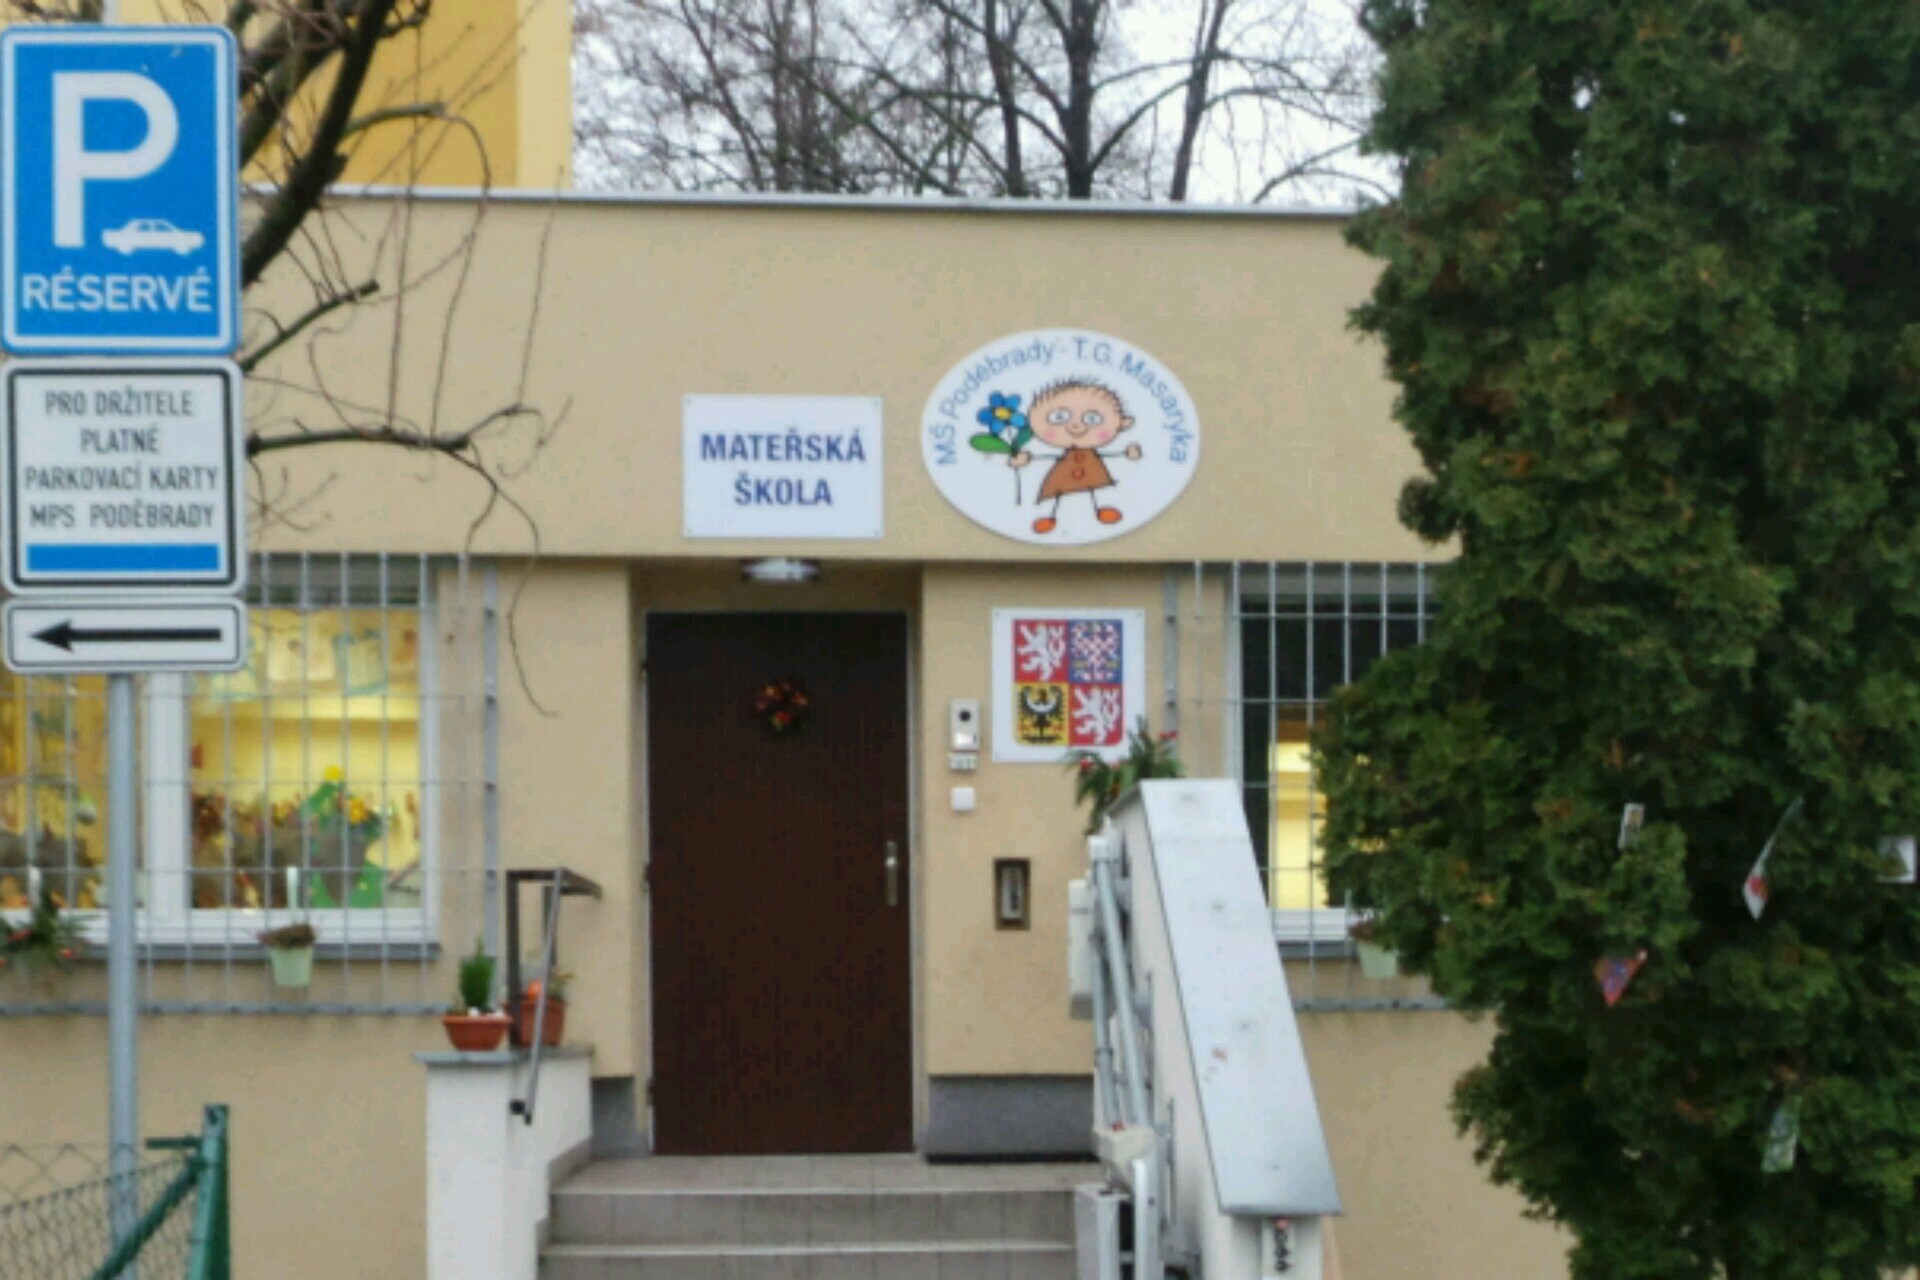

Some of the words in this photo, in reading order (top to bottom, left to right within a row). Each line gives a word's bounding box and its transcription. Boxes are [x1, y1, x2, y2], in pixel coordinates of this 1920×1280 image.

[53, 70, 180, 248] P
[21, 264, 213, 312] RÉSERVÉ
[45, 389, 86, 416] PRO
[95, 385, 193, 416] DRŽITELE
[928, 422, 957, 465] MŠ
[1119, 351, 1194, 463] Masaryka
[80, 424, 159, 453] PLATNÉ
[701, 426, 867, 462] MATEŘSKÁ
[24, 460, 142, 491] PARKOVACÍ
[150, 465, 218, 491] KARTY
[734, 471, 834, 506] ŠKOLA
[29, 503, 76, 528] MPS
[89, 498, 214, 528] PODĚBRADY
